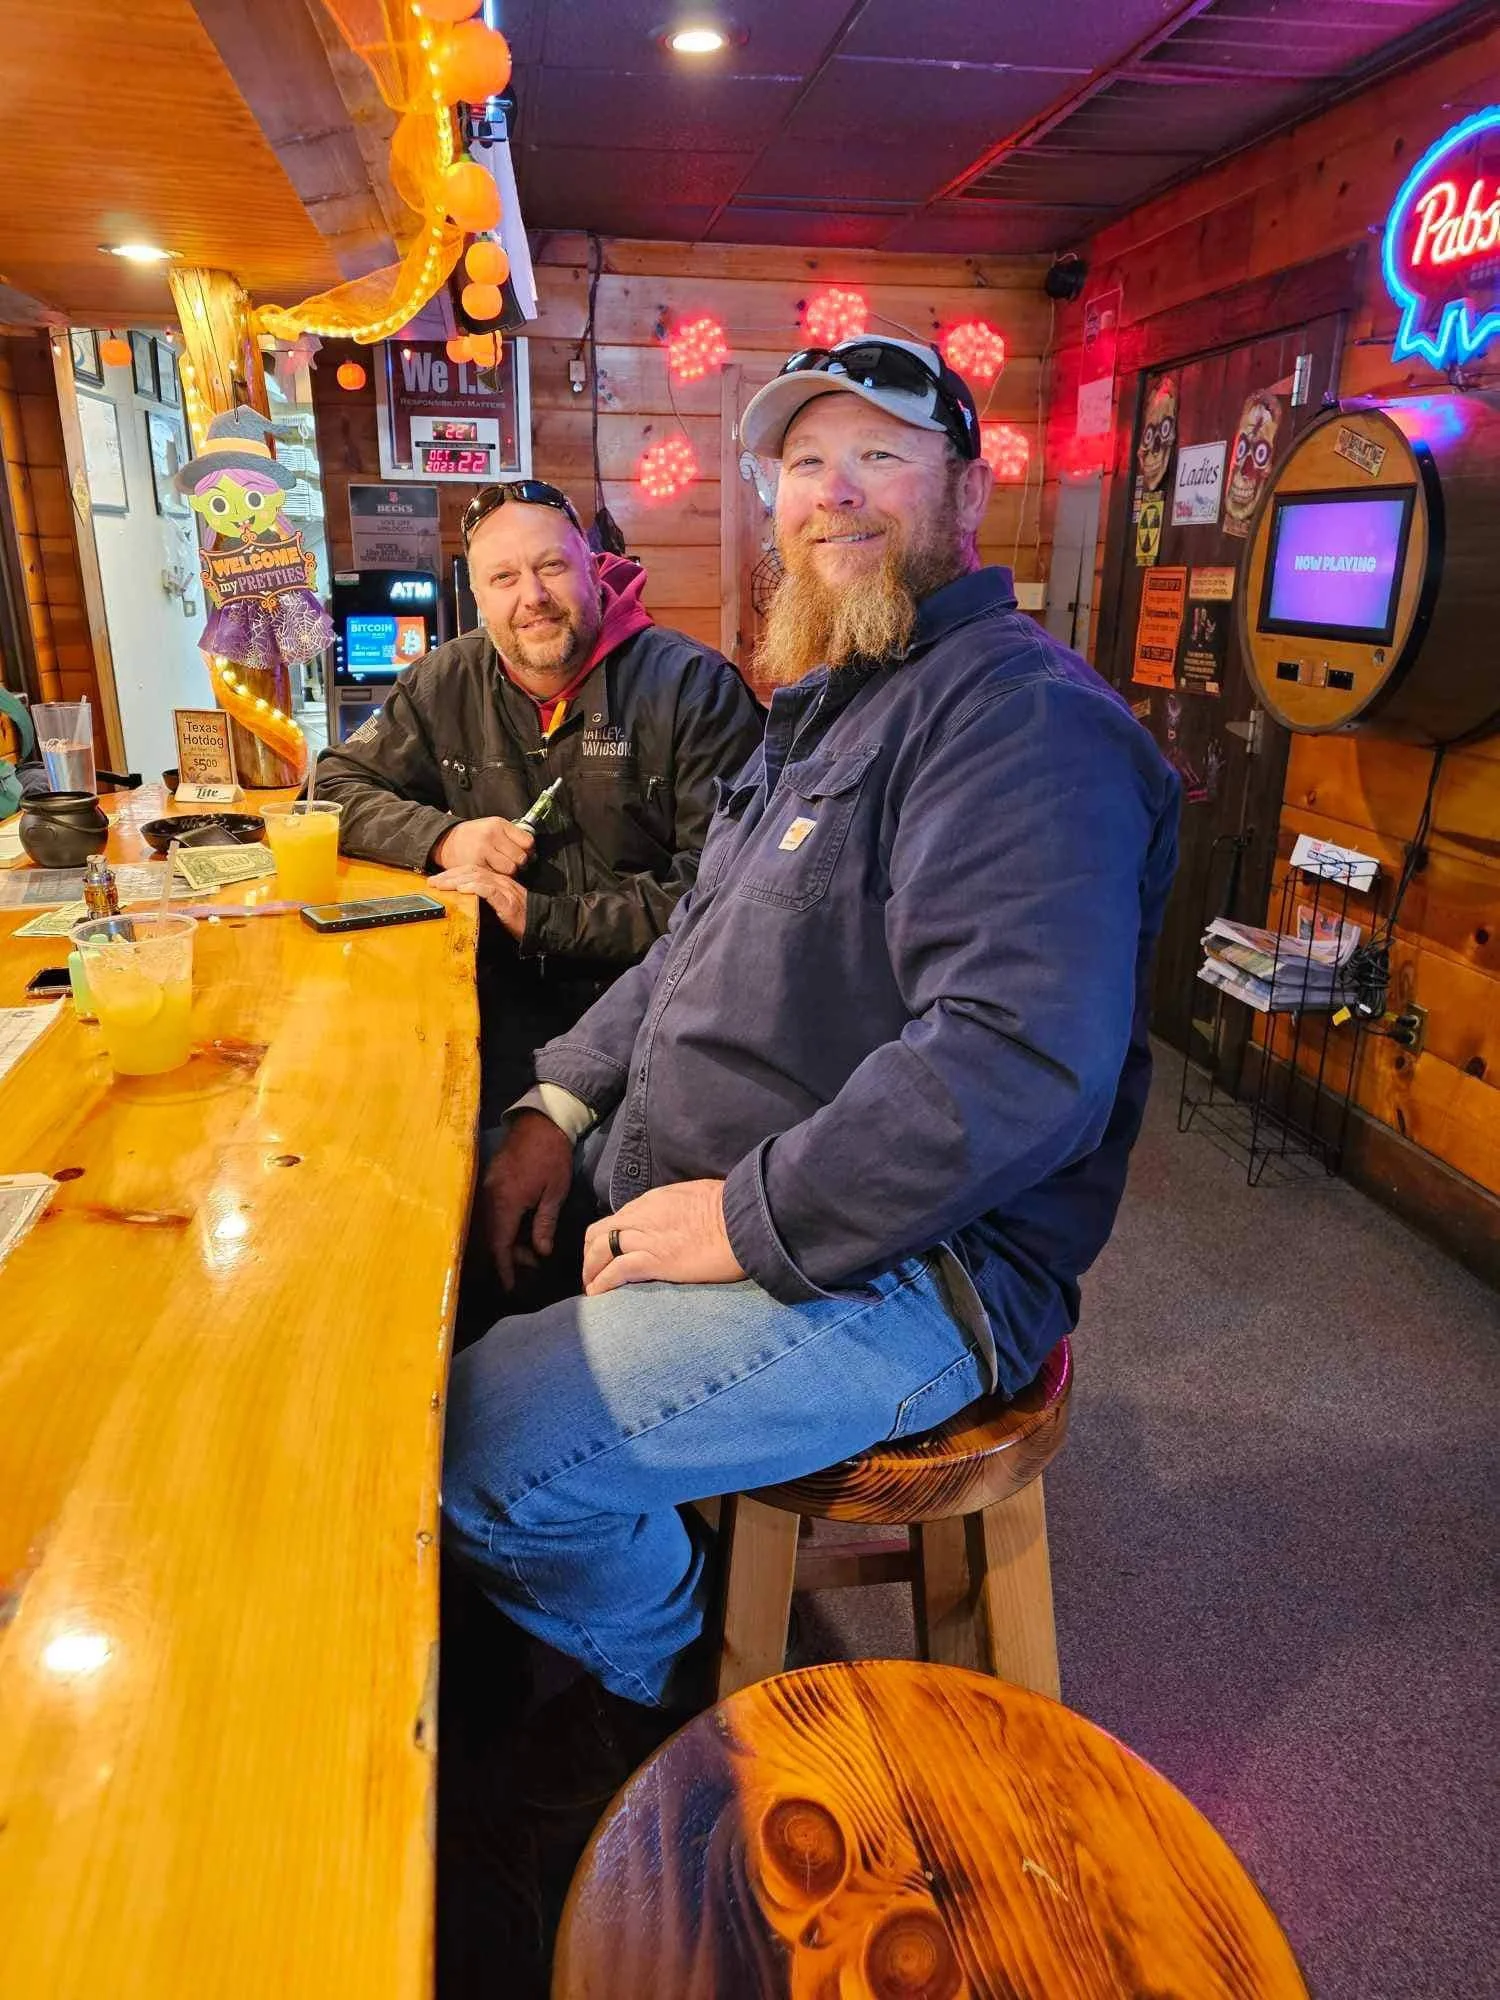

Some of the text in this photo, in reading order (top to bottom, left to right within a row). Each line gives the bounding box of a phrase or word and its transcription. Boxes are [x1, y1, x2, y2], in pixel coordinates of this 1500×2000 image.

[1411, 178, 1500, 266] Pabs
[401, 352, 448, 394] We
[429, 450, 451, 461] OCT
[458, 451, 487, 473] 22
[425, 461, 457, 473] 2023
[1179, 457, 1220, 487] Ladies
[211, 546, 300, 577] WELCOME
[1294, 555, 1377, 573] NOW PLAYING
[219, 566, 305, 596] my PRETTIES
[389, 581, 434, 600] ATM
[350, 623, 393, 633] BITCOIN
[185, 721, 218, 733] Texas
[183, 733, 224, 748] Hotdog
[582, 741, 632, 757] DAVIDSON
[195, 786, 220, 800] Lite
